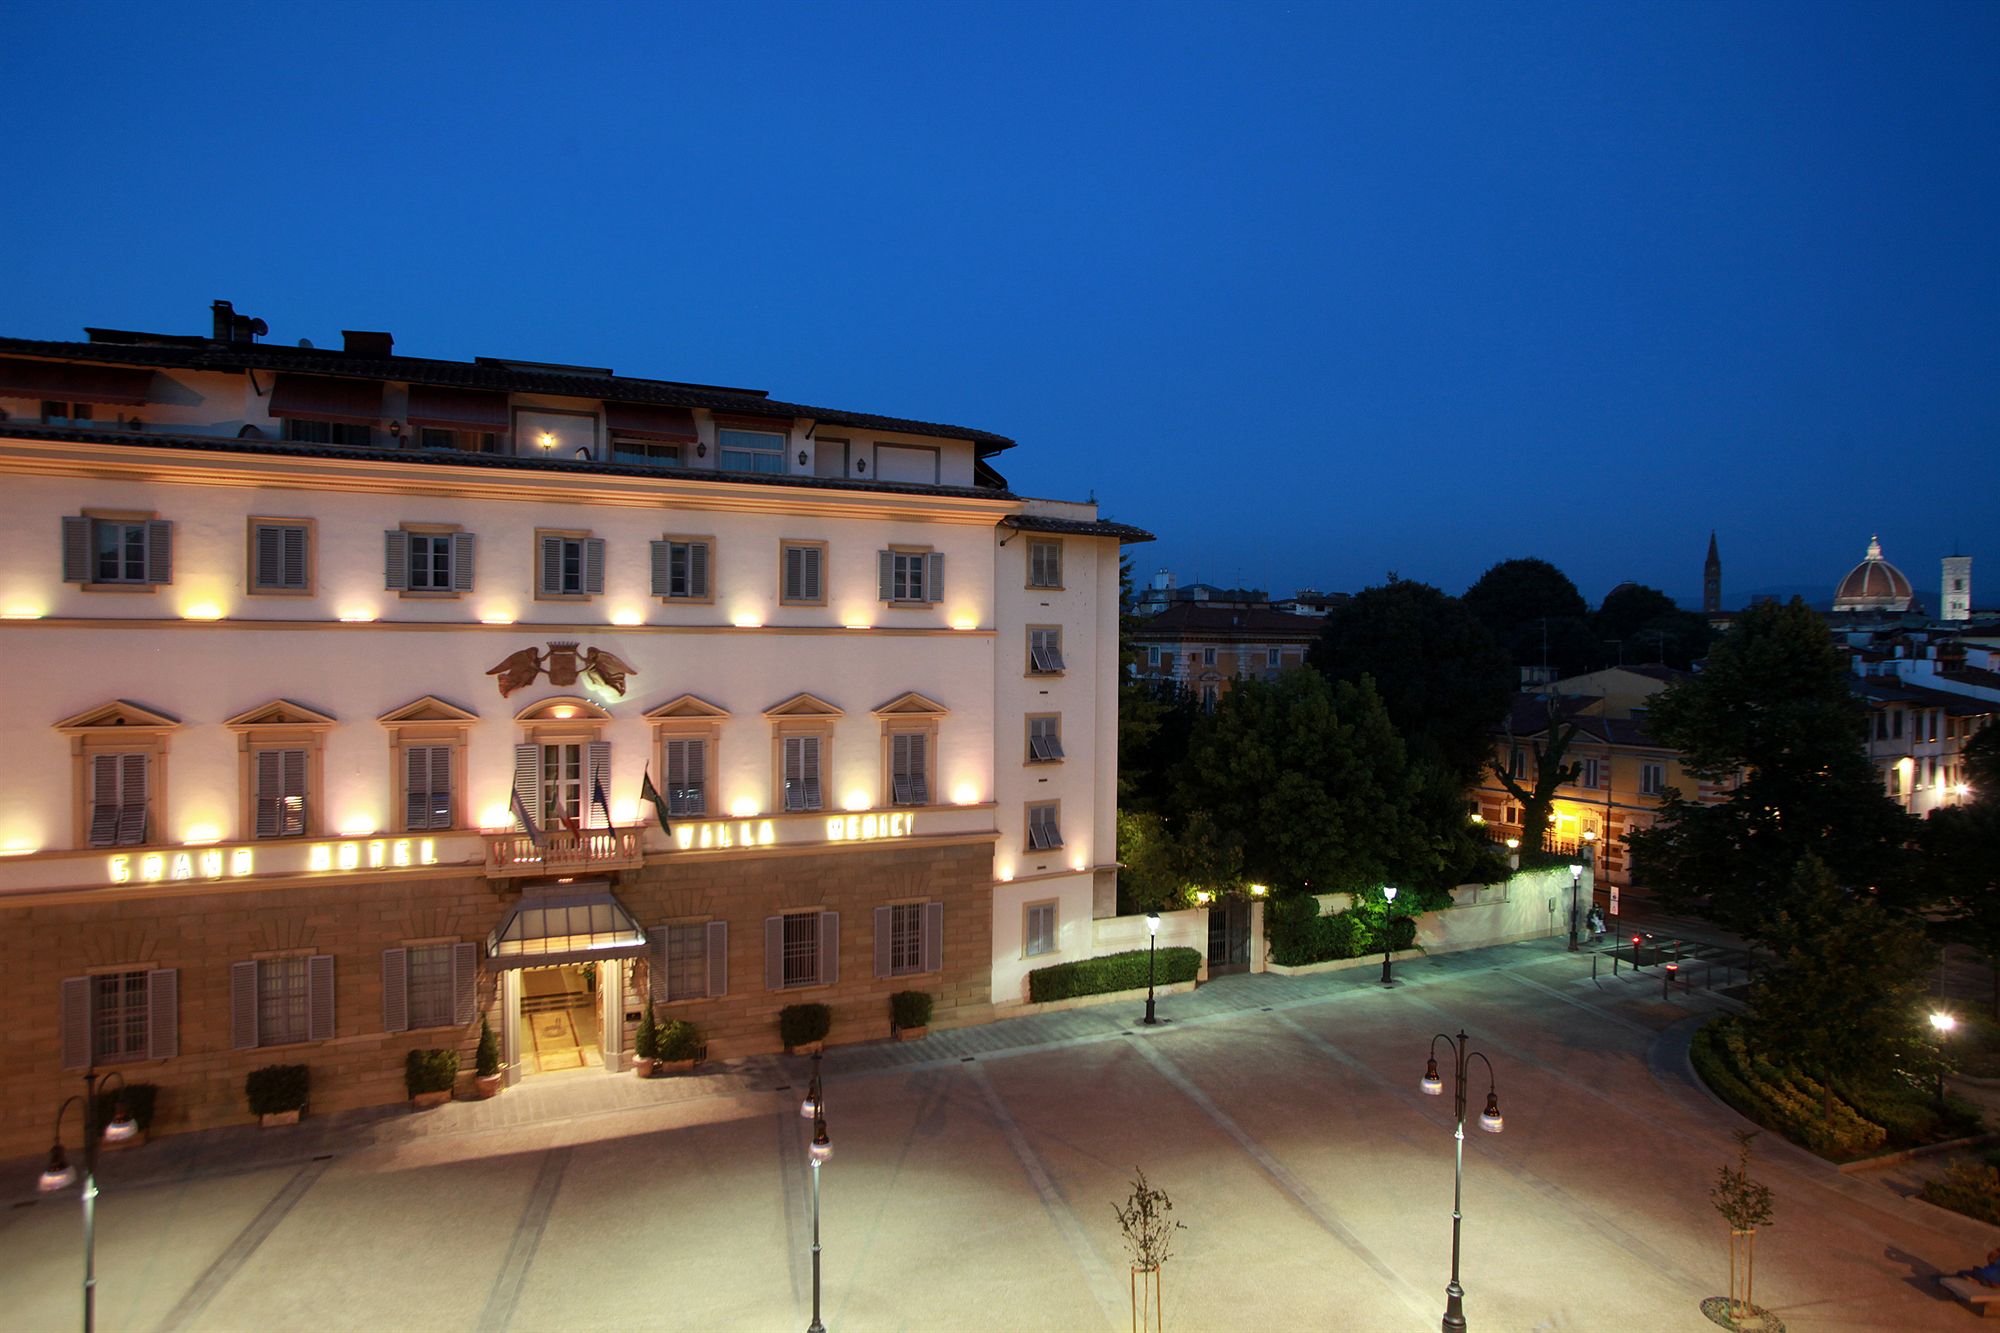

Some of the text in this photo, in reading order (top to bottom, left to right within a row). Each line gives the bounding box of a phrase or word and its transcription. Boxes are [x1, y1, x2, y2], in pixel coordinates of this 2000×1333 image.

[109, 813, 913, 884] GRAND HOTEL VILLA MEDICI
